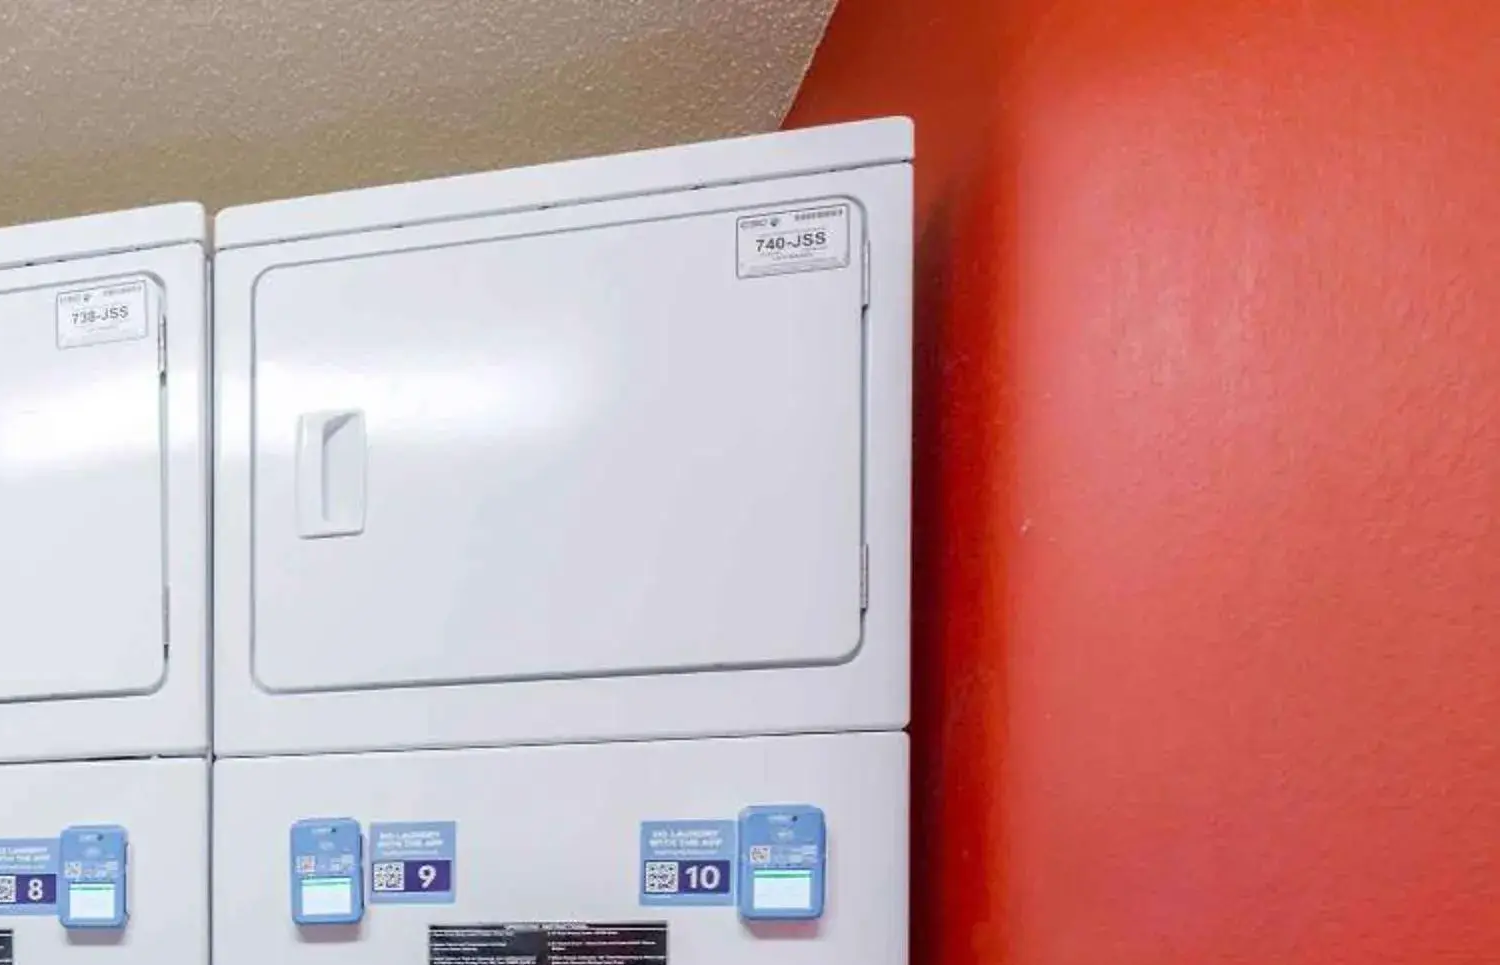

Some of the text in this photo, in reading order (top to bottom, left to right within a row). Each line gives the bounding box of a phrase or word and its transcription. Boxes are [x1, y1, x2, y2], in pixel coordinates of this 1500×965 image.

[756, 231, 827, 252] 740-JSS
[418, 865, 436, 888] 9
[685, 865, 721, 890] 10
[28, 878, 43, 901] 8
